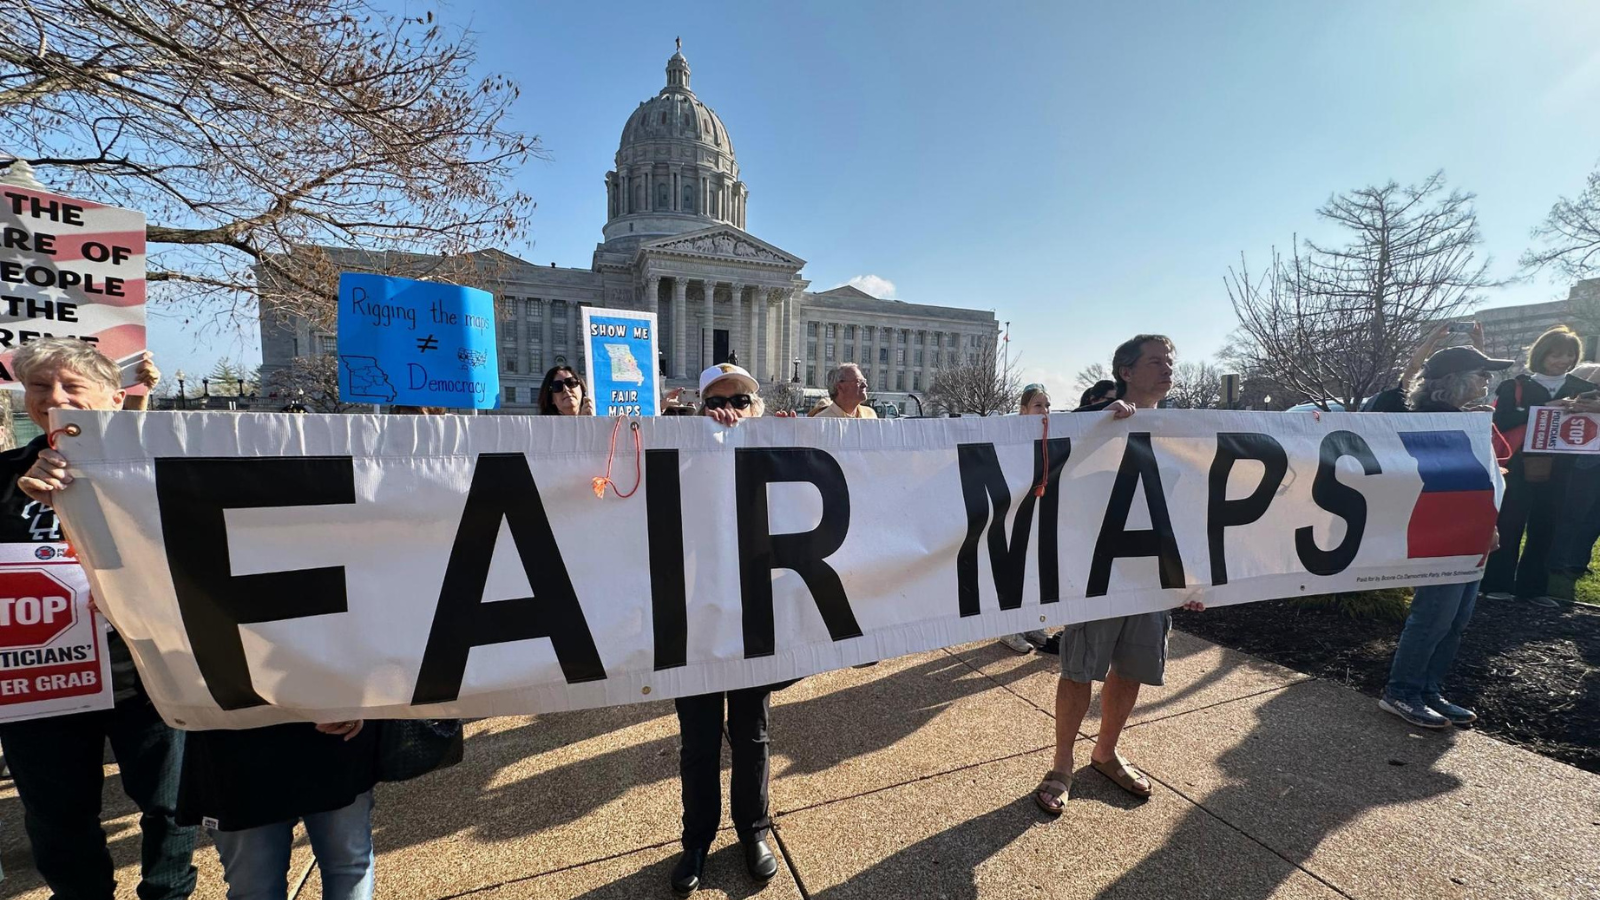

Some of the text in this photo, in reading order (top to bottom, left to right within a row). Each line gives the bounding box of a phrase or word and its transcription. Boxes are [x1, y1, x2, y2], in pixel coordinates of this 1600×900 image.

[4, 191, 85, 226] THE
[0, 226, 132, 265] RE OF
[0, 261, 125, 297] EOPLE
[1, 295, 79, 323] THE
[352, 287, 490, 337] Rigging the maps
[590, 323, 649, 340] SHOW ME
[407, 362, 486, 403] Democracy
[611, 390, 639, 403] FAIR
[608, 405, 641, 417] MAPS
[1569, 418, 1585, 444] STOP
[155, 430, 1383, 710] FAIR MAPS
[0, 596, 68, 627] TOP
[0, 645, 92, 668] TICIANS'
[35, 671, 97, 692] GRAB
